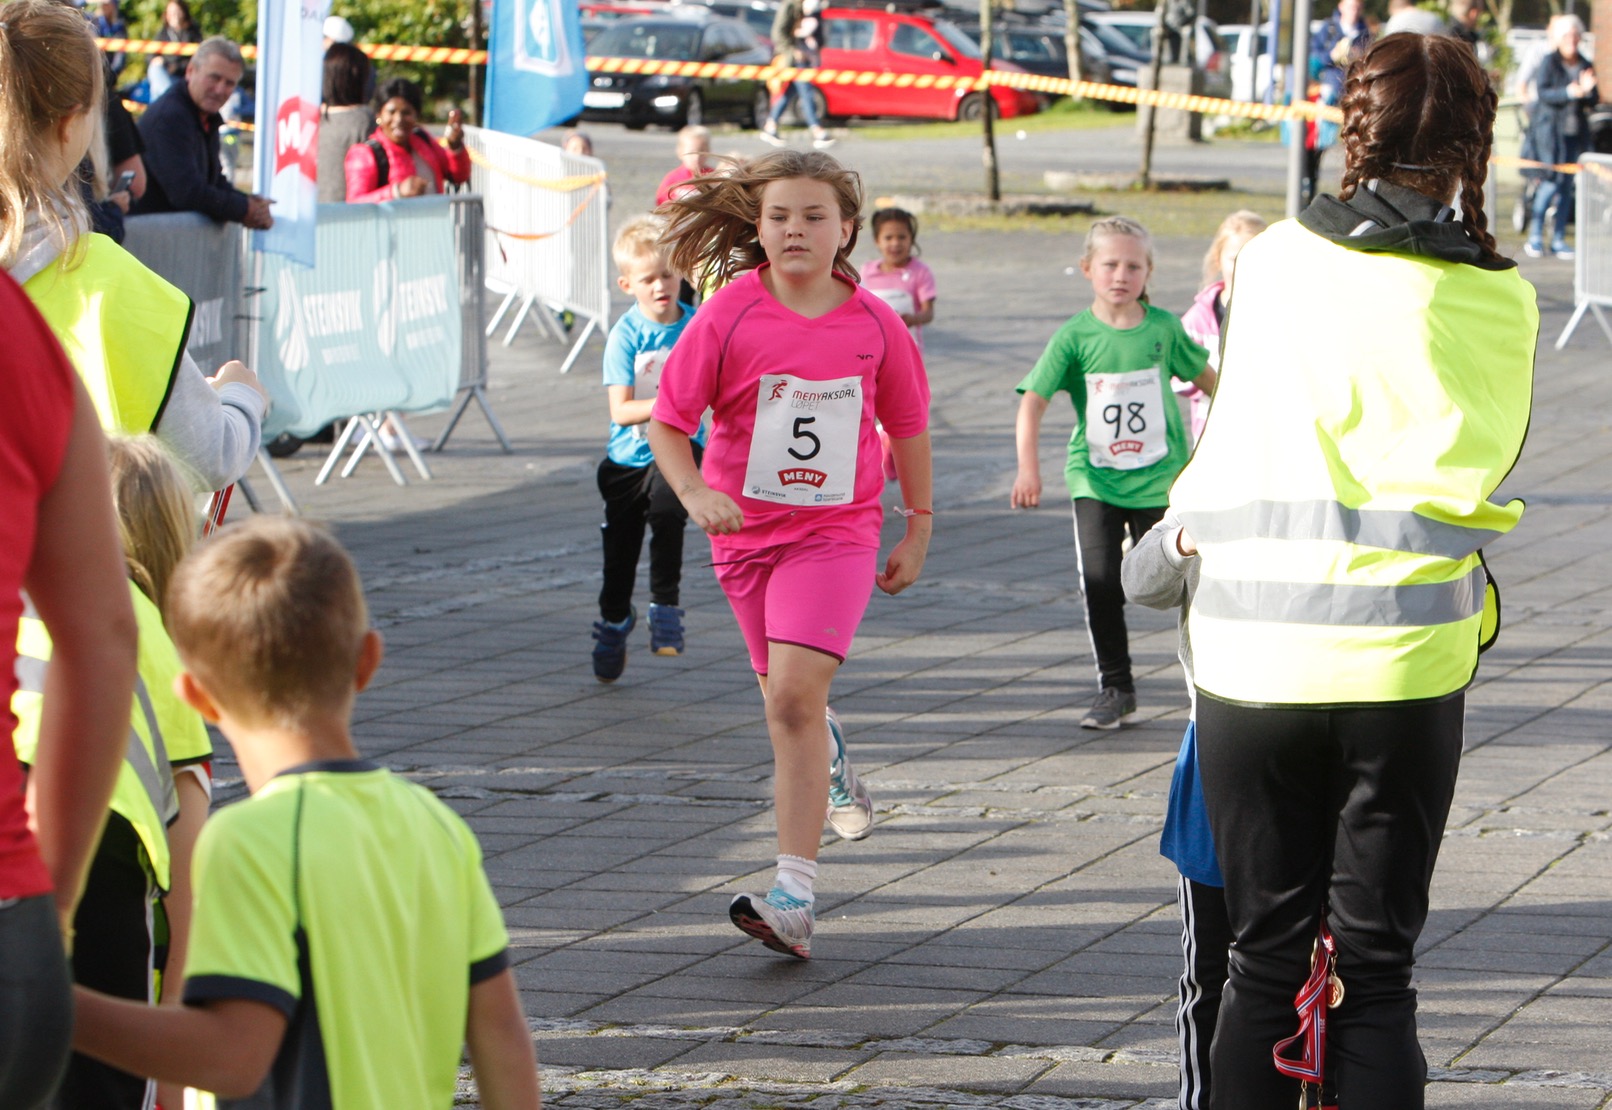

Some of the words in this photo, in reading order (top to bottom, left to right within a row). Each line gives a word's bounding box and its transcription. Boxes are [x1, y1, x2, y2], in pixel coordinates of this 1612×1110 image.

[792, 388, 856, 401] MENYAKSDAL
[1103, 402, 1146, 439] 98
[787, 416, 821, 461] 5
[783, 471, 823, 484] MENY
